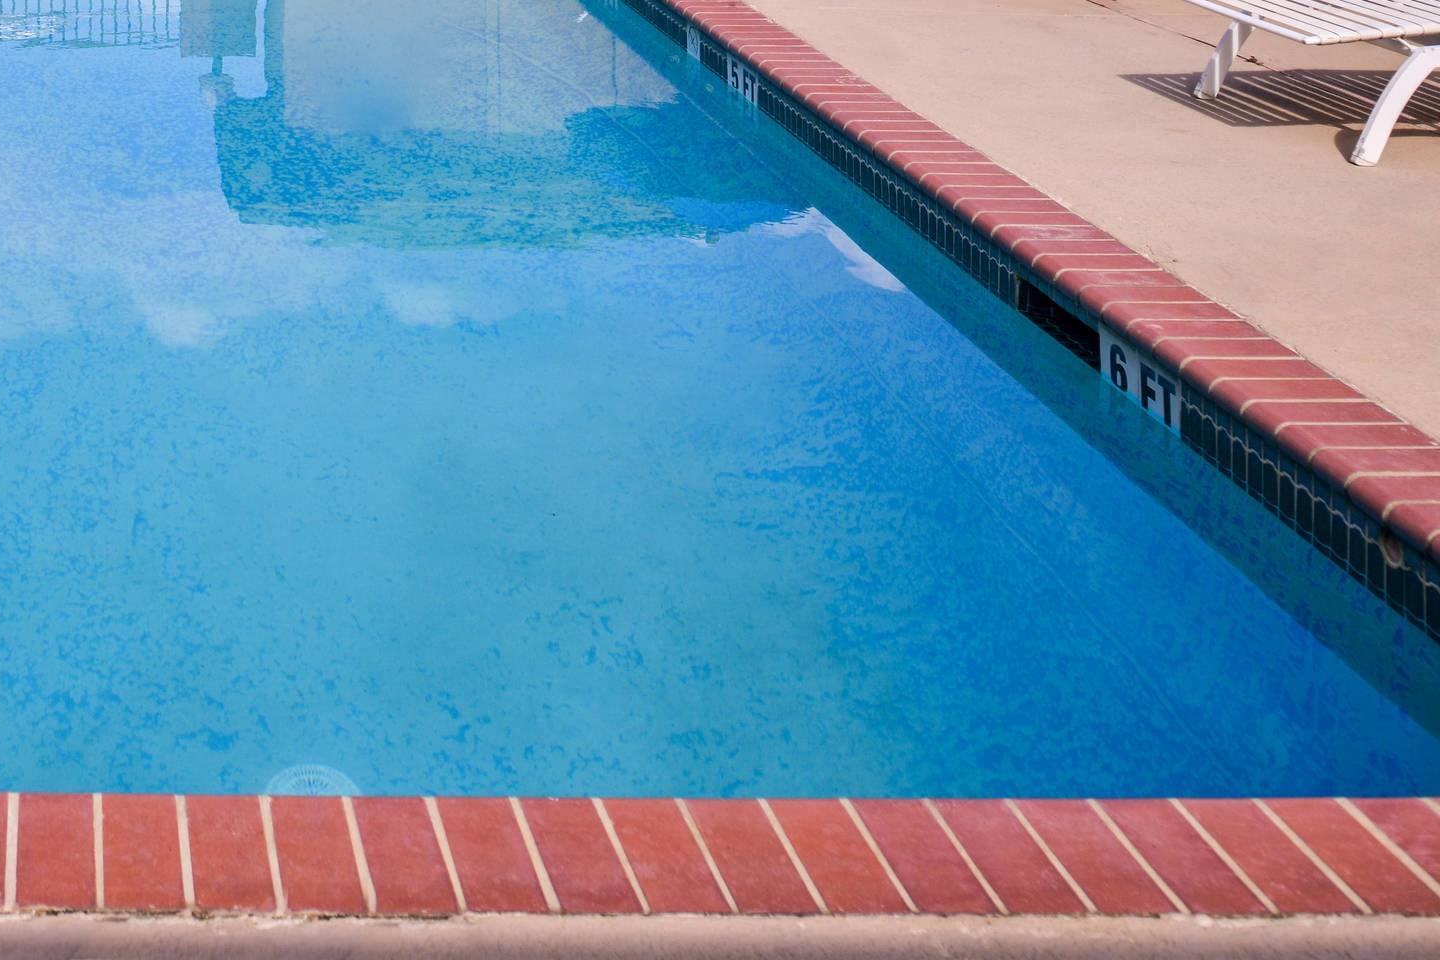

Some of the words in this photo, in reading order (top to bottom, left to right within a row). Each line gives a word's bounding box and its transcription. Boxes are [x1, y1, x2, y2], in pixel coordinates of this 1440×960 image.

[731, 60, 739, 90] 5
[743, 68, 756, 103] FT
[1110, 344, 1128, 392] 6
[1140, 362, 1176, 428] FT
